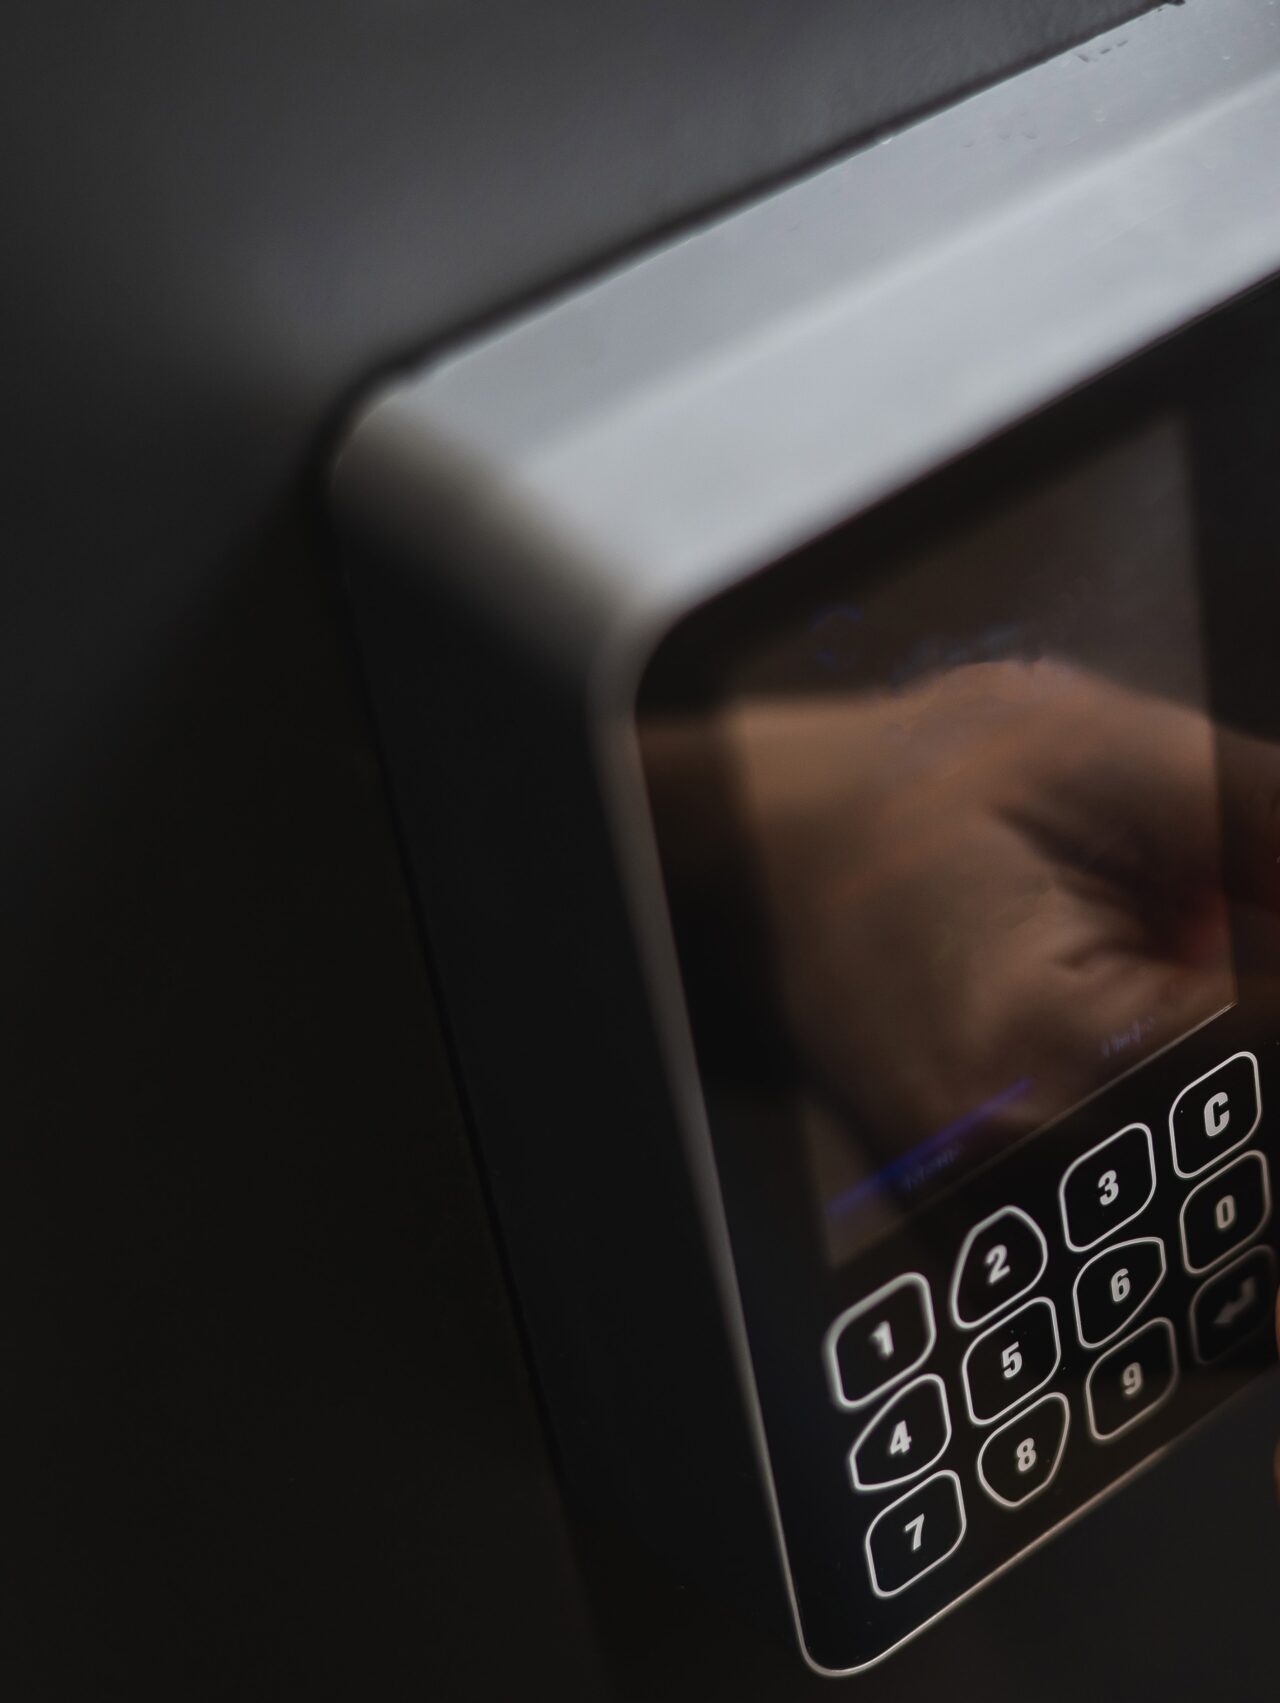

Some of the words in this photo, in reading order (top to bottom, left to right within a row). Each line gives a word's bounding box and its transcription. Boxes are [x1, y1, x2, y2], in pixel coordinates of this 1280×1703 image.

[1202, 1091, 1231, 1137] C
[1096, 1169, 1120, 1206] 3
[1214, 1195, 1237, 1230] 0
[984, 1244, 1012, 1284] 2
[1109, 1268, 1132, 1303] 6
[871, 1321, 895, 1357] 1
[1000, 1341, 1024, 1379] 5
[1121, 1362, 1144, 1396] 9
[888, 1420, 913, 1455] 4
[1015, 1437, 1038, 1473] 8
[903, 1513, 926, 1551] 7
